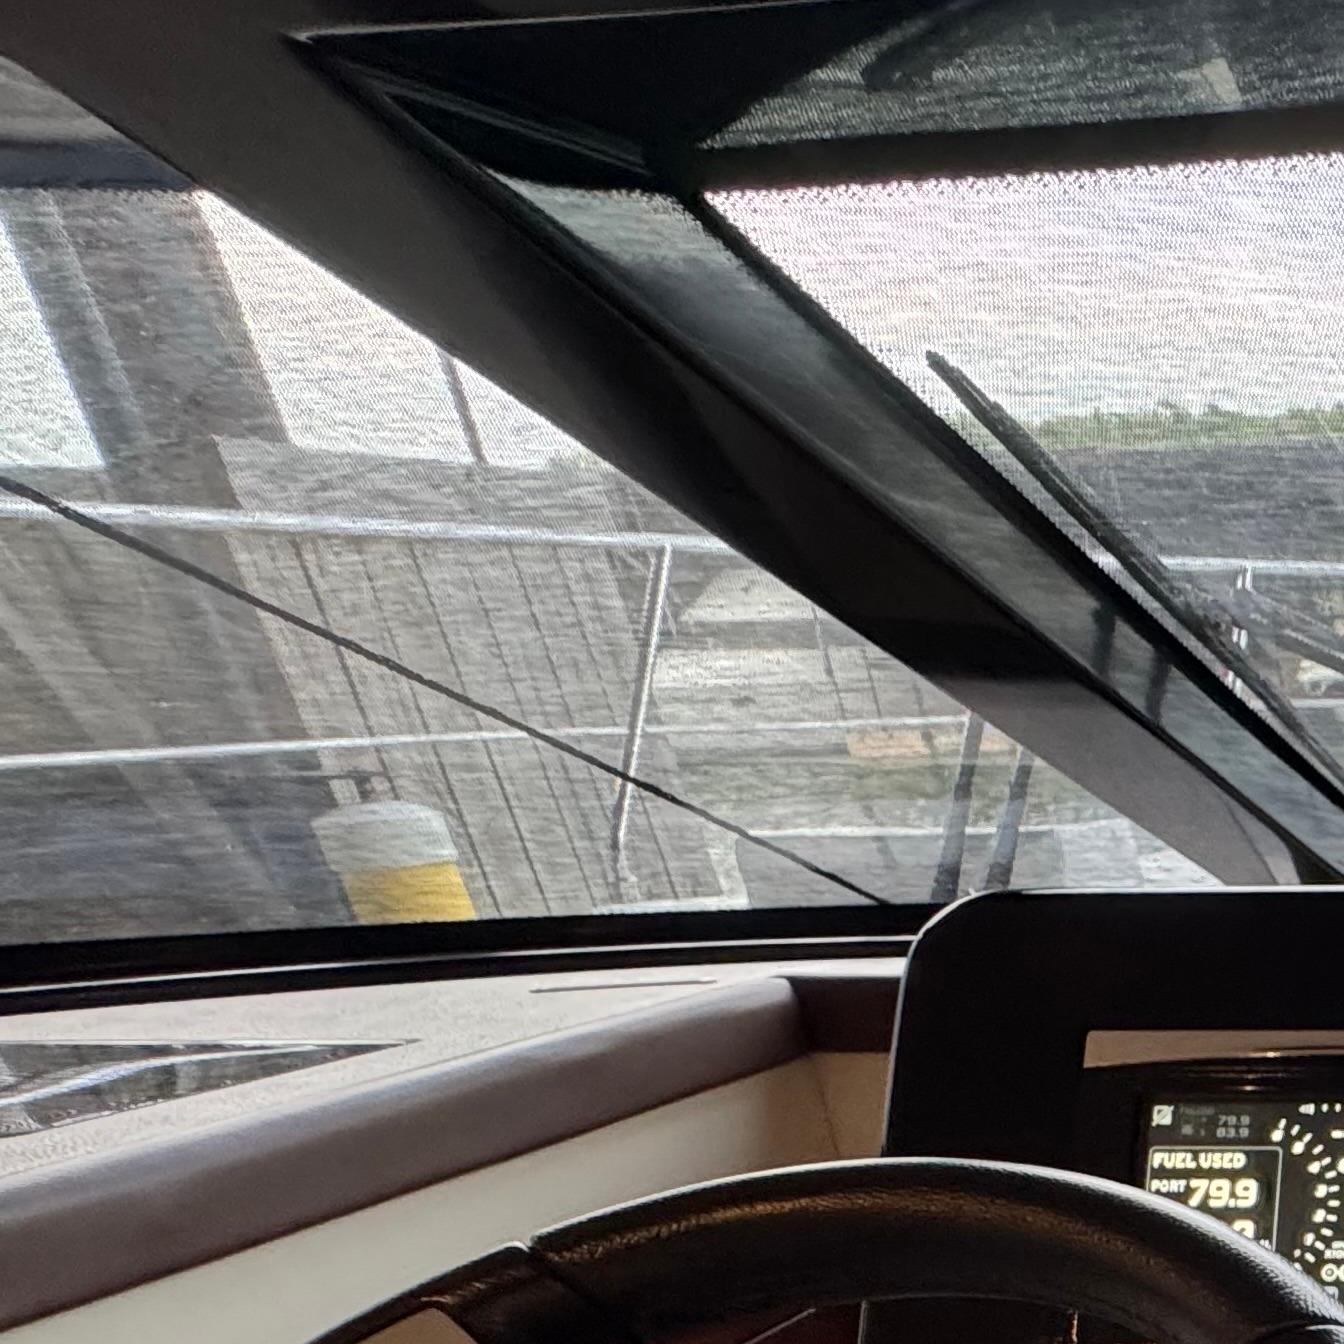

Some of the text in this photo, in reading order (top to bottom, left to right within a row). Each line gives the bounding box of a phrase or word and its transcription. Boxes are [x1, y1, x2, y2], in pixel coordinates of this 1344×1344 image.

[1151, 1151, 1248, 1170] FUEL USED
[1150, 1177, 1260, 1209] PORT 79.9
